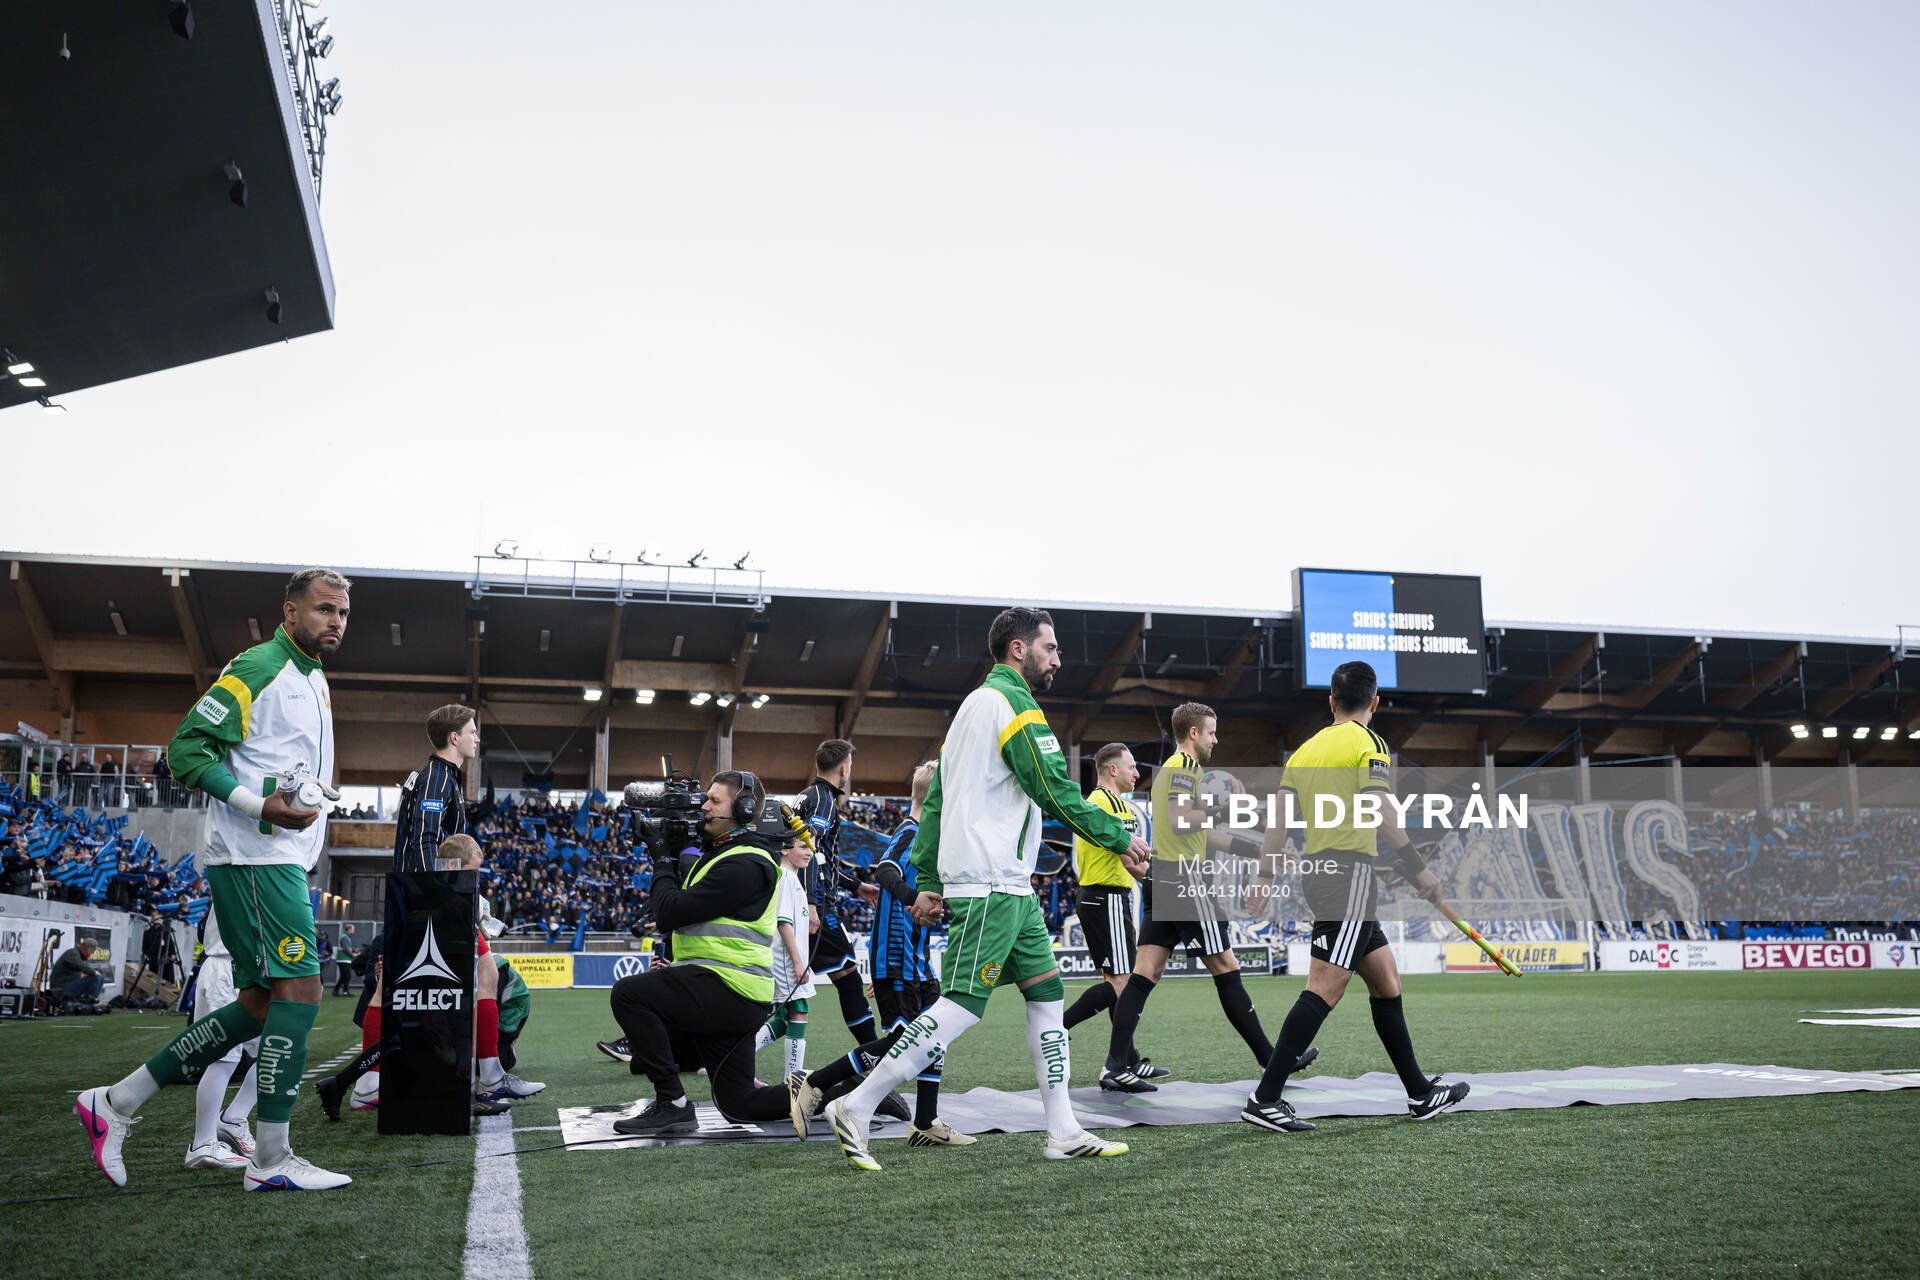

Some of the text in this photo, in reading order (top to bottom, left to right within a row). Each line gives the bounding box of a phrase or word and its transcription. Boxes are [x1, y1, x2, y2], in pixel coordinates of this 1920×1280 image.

[1353, 611, 1434, 631] SIRIUS SIRIUUUS
[1310, 632, 1344, 650] SIRIUS
[1388, 635, 1421, 652] SIRIUS
[203, 700, 225, 719] UNIBE
[1058, 955, 1096, 972] Club
[1480, 945, 1556, 963] BKLÄDER
[1629, 948, 1679, 964] DALOC
[1745, 944, 1866, 968] BEVEGO
[392, 989, 464, 1010] SELECT
[170, 1018, 228, 1061] Clinton
[258, 1035, 294, 1095] Clinton
[1041, 1030, 1066, 1085] Clinton
